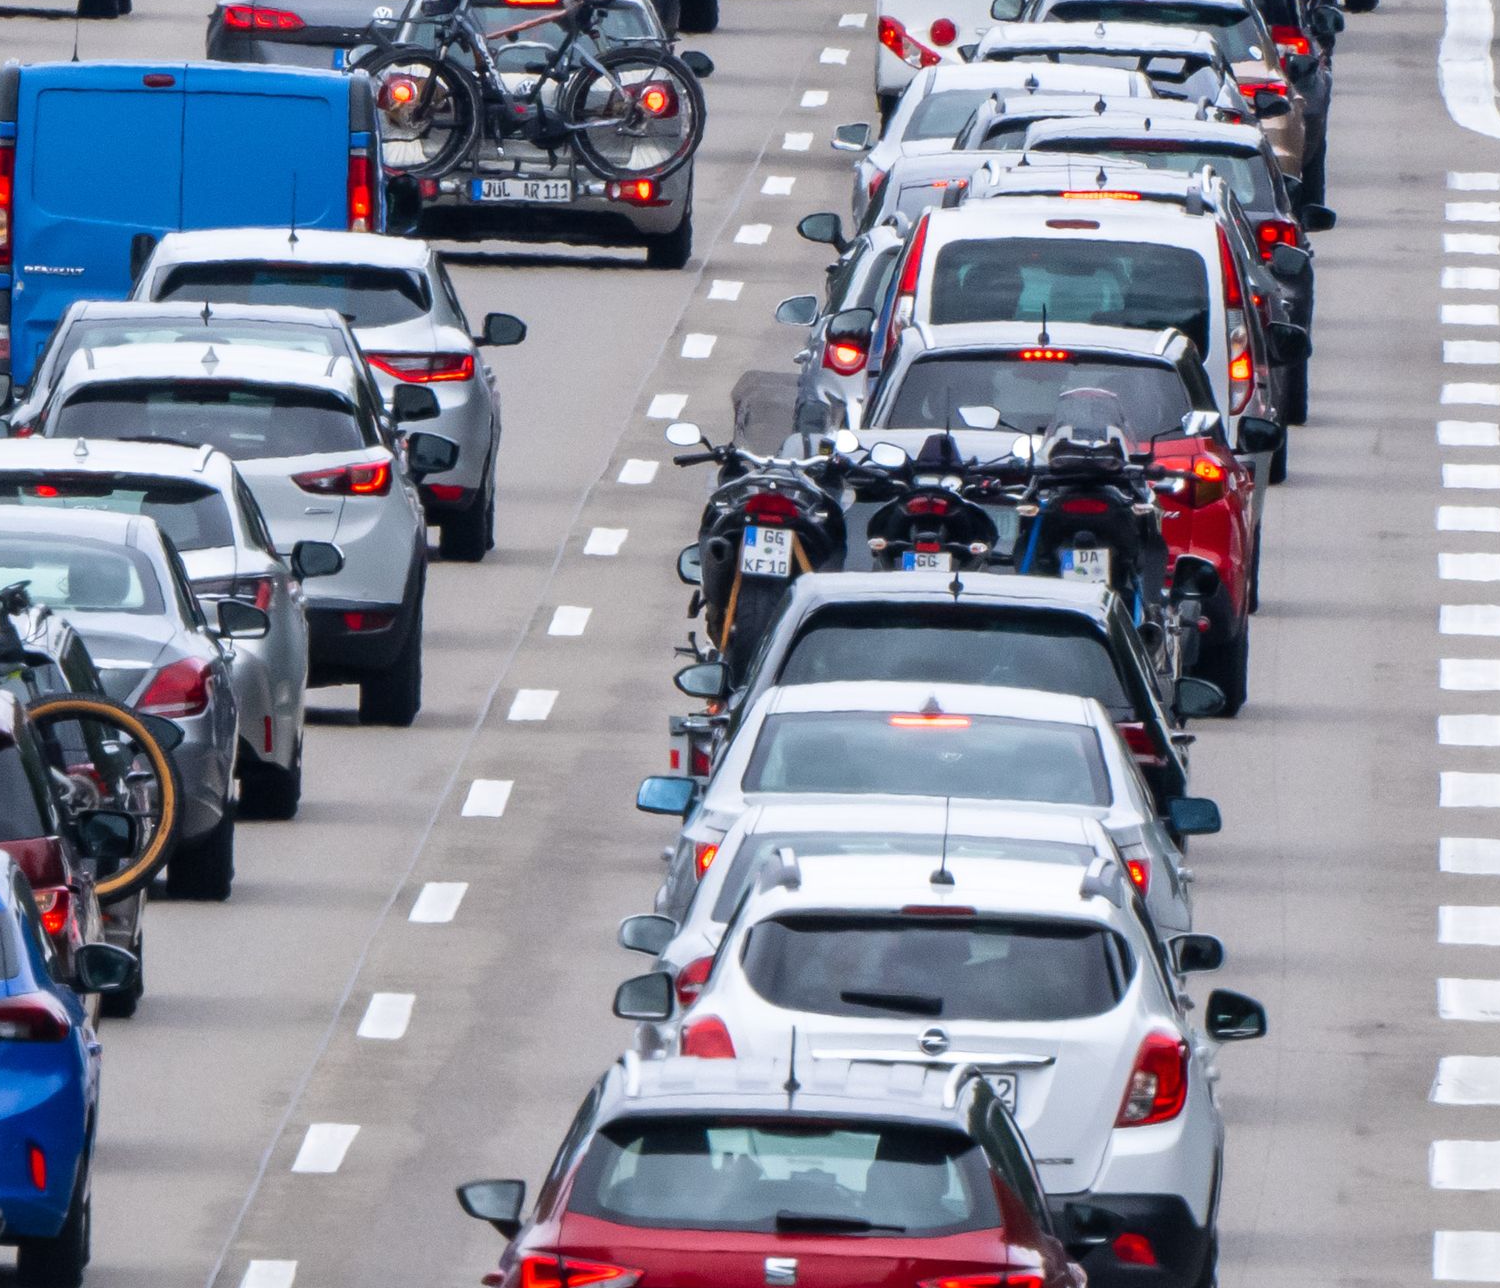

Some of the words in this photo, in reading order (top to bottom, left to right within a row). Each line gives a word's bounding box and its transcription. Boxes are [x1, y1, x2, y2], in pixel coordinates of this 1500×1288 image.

[543, 182, 569, 201] 111
[763, 529, 785, 548] GG
[915, 554, 938, 569] GG
[1079, 550, 1100, 564] DA
[744, 558, 764, 574] KF
